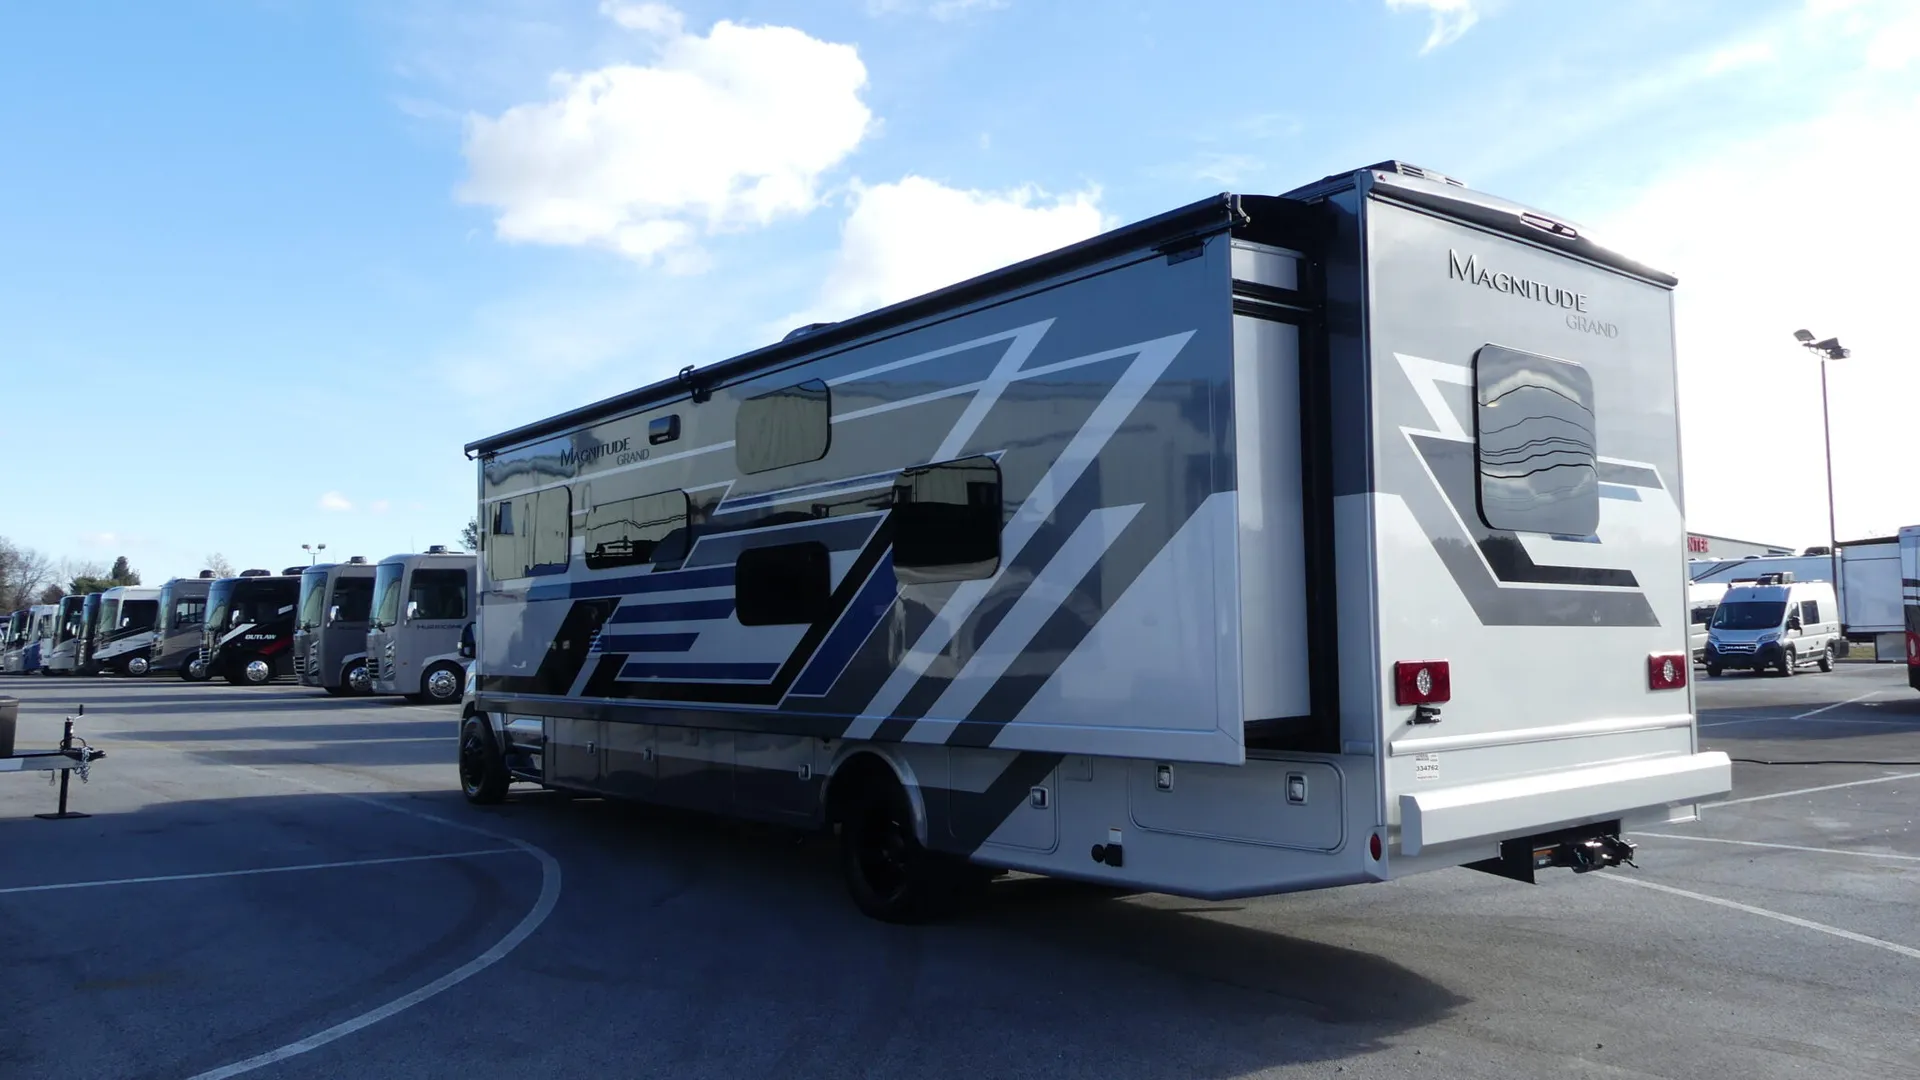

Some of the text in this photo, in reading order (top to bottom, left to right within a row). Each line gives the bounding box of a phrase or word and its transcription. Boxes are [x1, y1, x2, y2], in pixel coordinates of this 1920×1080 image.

[1448, 248, 1588, 313] MAGNITUDE
[1566, 314, 1619, 340] GRAND
[560, 437, 631, 467] MAGNITUDE
[616, 448, 650, 466] GRAND
[245, 633, 277, 641] OUTLAW
